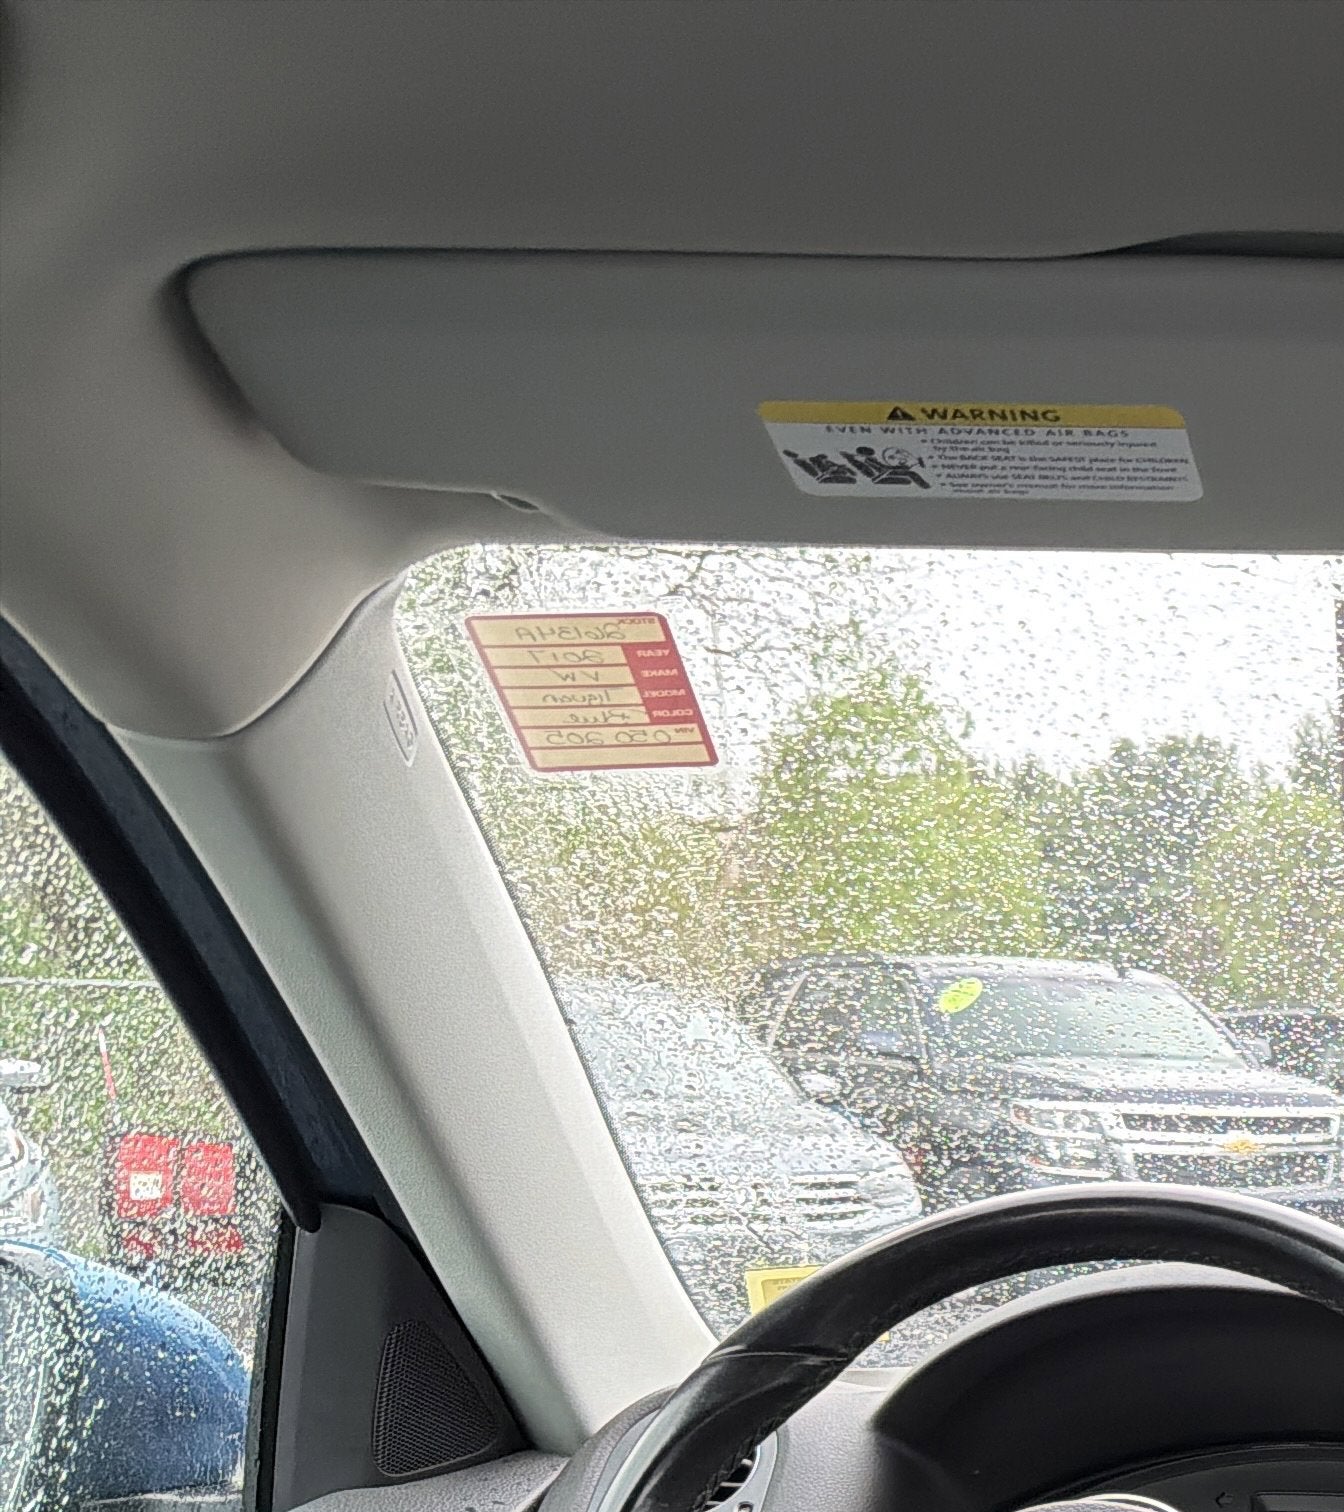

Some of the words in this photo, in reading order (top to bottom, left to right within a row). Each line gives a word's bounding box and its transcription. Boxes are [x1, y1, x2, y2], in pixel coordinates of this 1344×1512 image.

[922, 407, 1061, 423] WARNING
[826, 425, 872, 434] EVEN
[881, 426, 928, 435] WITH
[938, 427, 1036, 437] ADVANCED
[1046, 429, 1074, 437] AIR
[1083, 429, 1129, 438] BAGS
